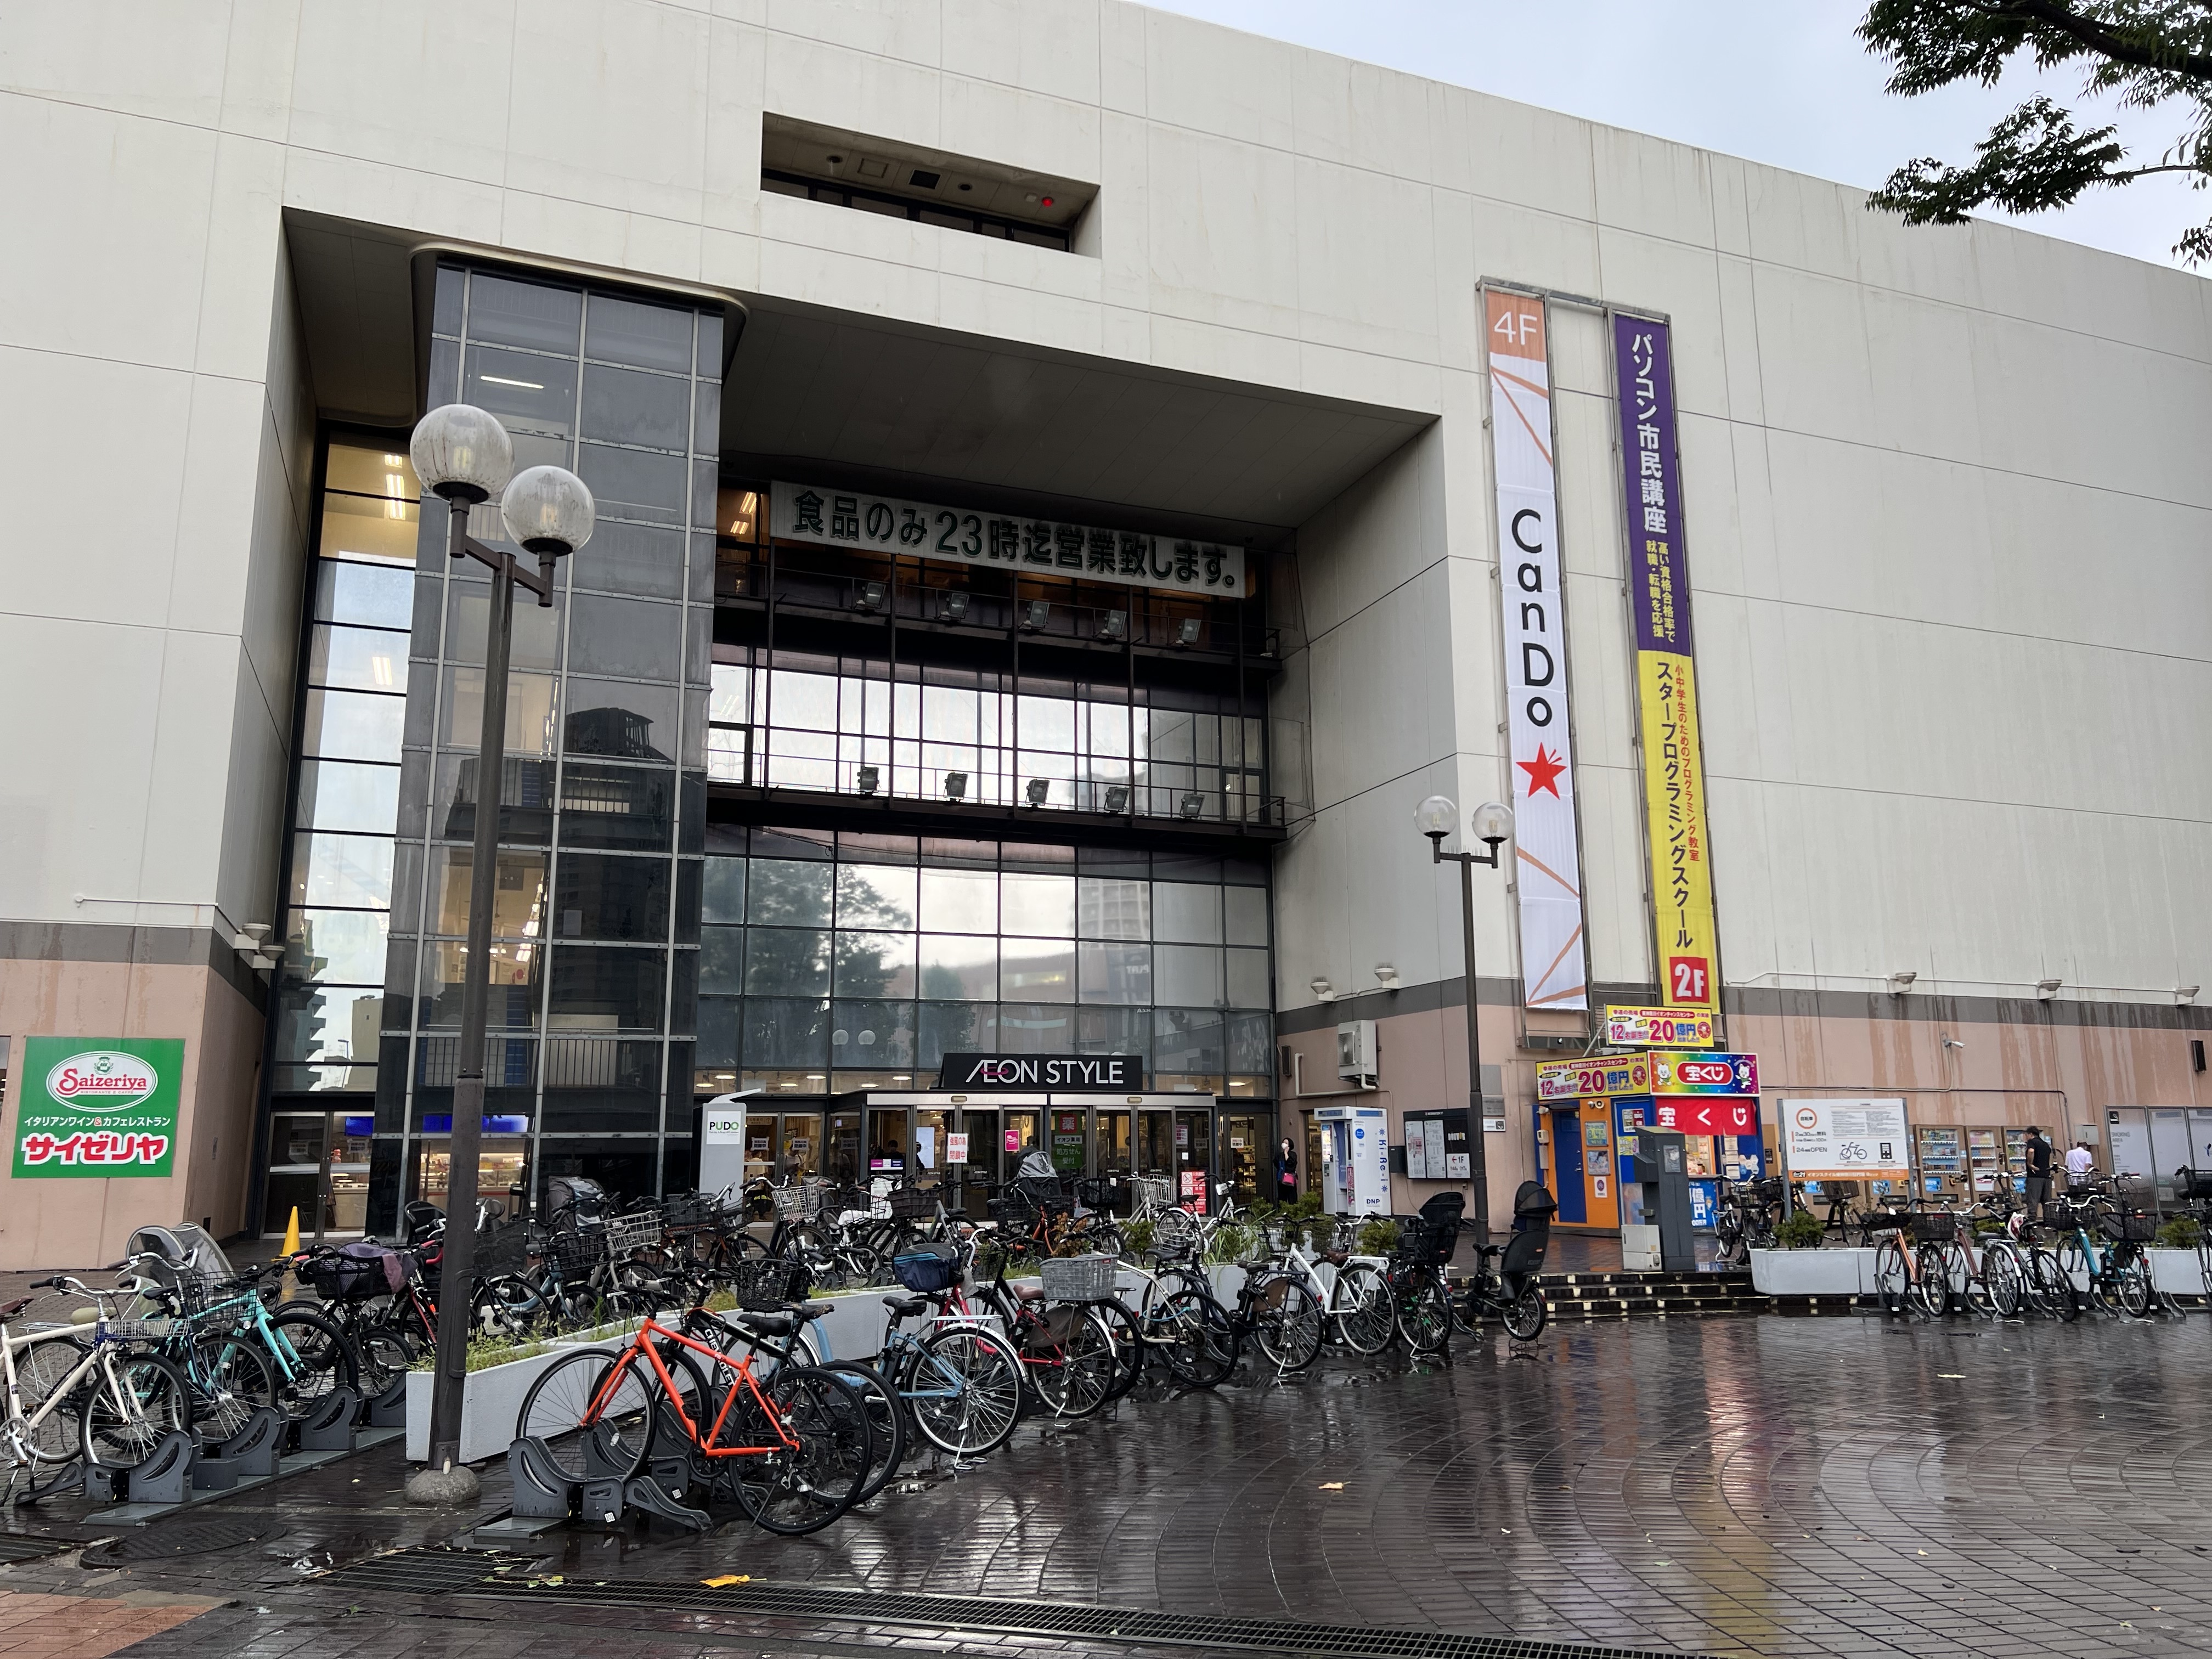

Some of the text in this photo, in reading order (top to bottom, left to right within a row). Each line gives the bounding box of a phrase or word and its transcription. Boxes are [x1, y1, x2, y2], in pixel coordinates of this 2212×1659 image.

[1494, 311, 1538, 346] 4F
[1632, 334, 1668, 534] パソコン市民講座
[793, 489, 1235, 587] 食品のみ23時迄営業致します。
[1511, 508, 1555, 727] CanDo
[1657, 662, 1693, 949] スタープログラミングスクール
[1674, 963, 1705, 998] 2F
[58, 1068, 147, 1092] Saizeriya
[1046, 1059, 1124, 1085] STYLE
[1685, 1065, 1724, 1081] 宝くじ
[709, 1121, 740, 1131] PUDO
[1062, 1116, 1075, 1130] 薬
[24, 1133, 167, 1163] サイゼリヤ
[949, 1136, 967, 1146] 強風の為
